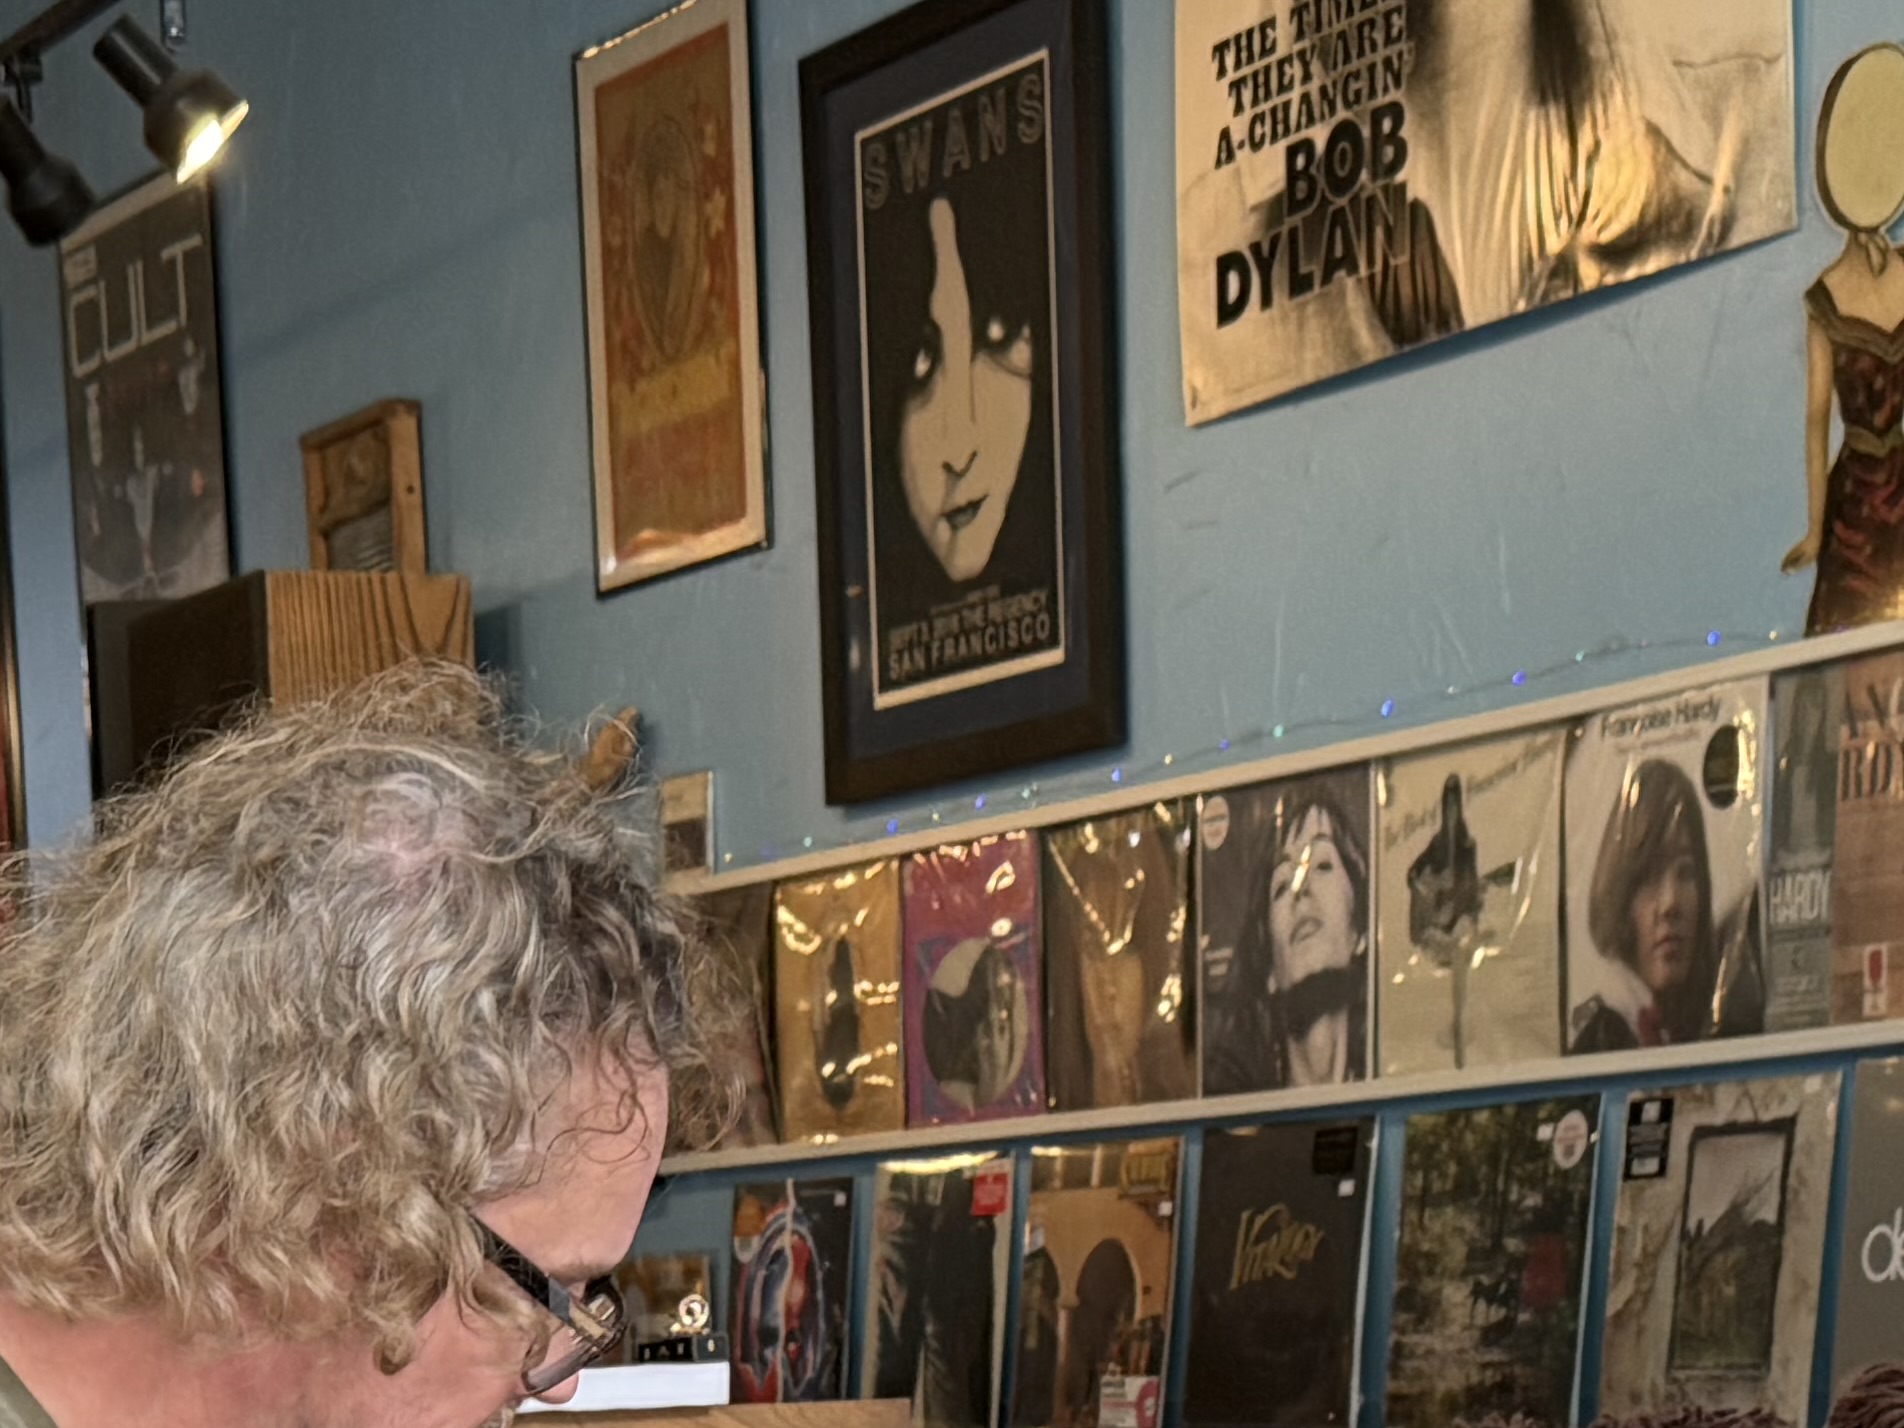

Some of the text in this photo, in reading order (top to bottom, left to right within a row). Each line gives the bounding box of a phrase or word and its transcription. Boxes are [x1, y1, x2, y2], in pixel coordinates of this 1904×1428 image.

[1211, 15, 1278, 82] THE
[1227, 5, 1406, 118] THEY ARE
[863, 73, 1044, 210] SWANS
[1285, 100, 1409, 218] BOB
[68, 233, 203, 379] CULT
[1215, 179, 1411, 330] DYLAN
[888, 648, 927, 683] SAN
[929, 611, 1052, 669] FRANCISCO
[1768, 865, 1832, 923] HARDY
